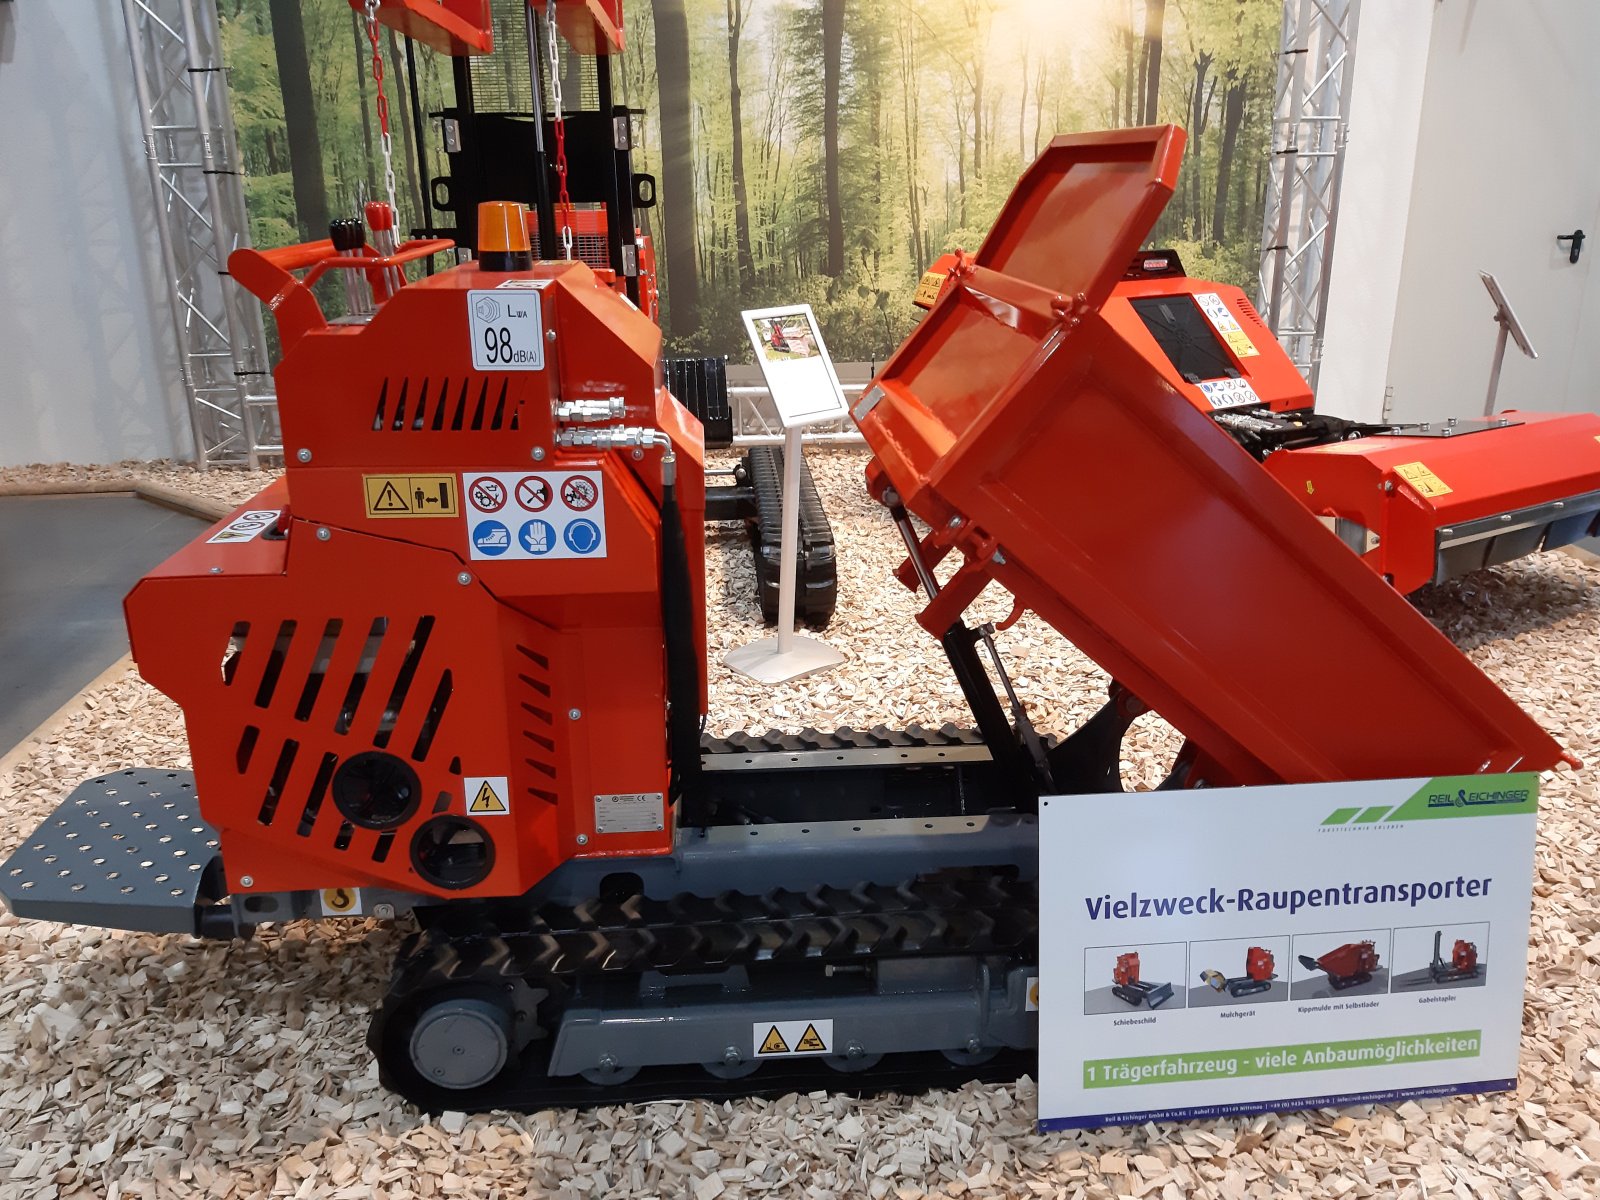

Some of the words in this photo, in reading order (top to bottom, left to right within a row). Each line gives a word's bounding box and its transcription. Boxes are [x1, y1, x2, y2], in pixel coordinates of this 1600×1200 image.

[484, 327, 513, 363] 98
[1428, 794, 1453, 804] REIL
[1469, 789, 1530, 802] EICHINGER
[1085, 875, 1493, 921] Vielzweck-Raupentransporter
[1418, 995, 1457, 1004] Gabelstapler
[1298, 1004, 1332, 1013] Kippmulde
[1345, 1001, 1380, 1010] Selbstlader
[1220, 1010, 1256, 1019] Mulchgerät
[1113, 1017, 1157, 1026] Schiebeschild
[1087, 1066, 1097, 1081] 1
[1103, 1054, 1238, 1083] Trägerfahrzeug
[1255, 1050, 1297, 1069] viele
[1302, 1035, 1478, 1066] Anbaumöglichkeiten
[1122, 1114, 1147, 1122] Eichinger
